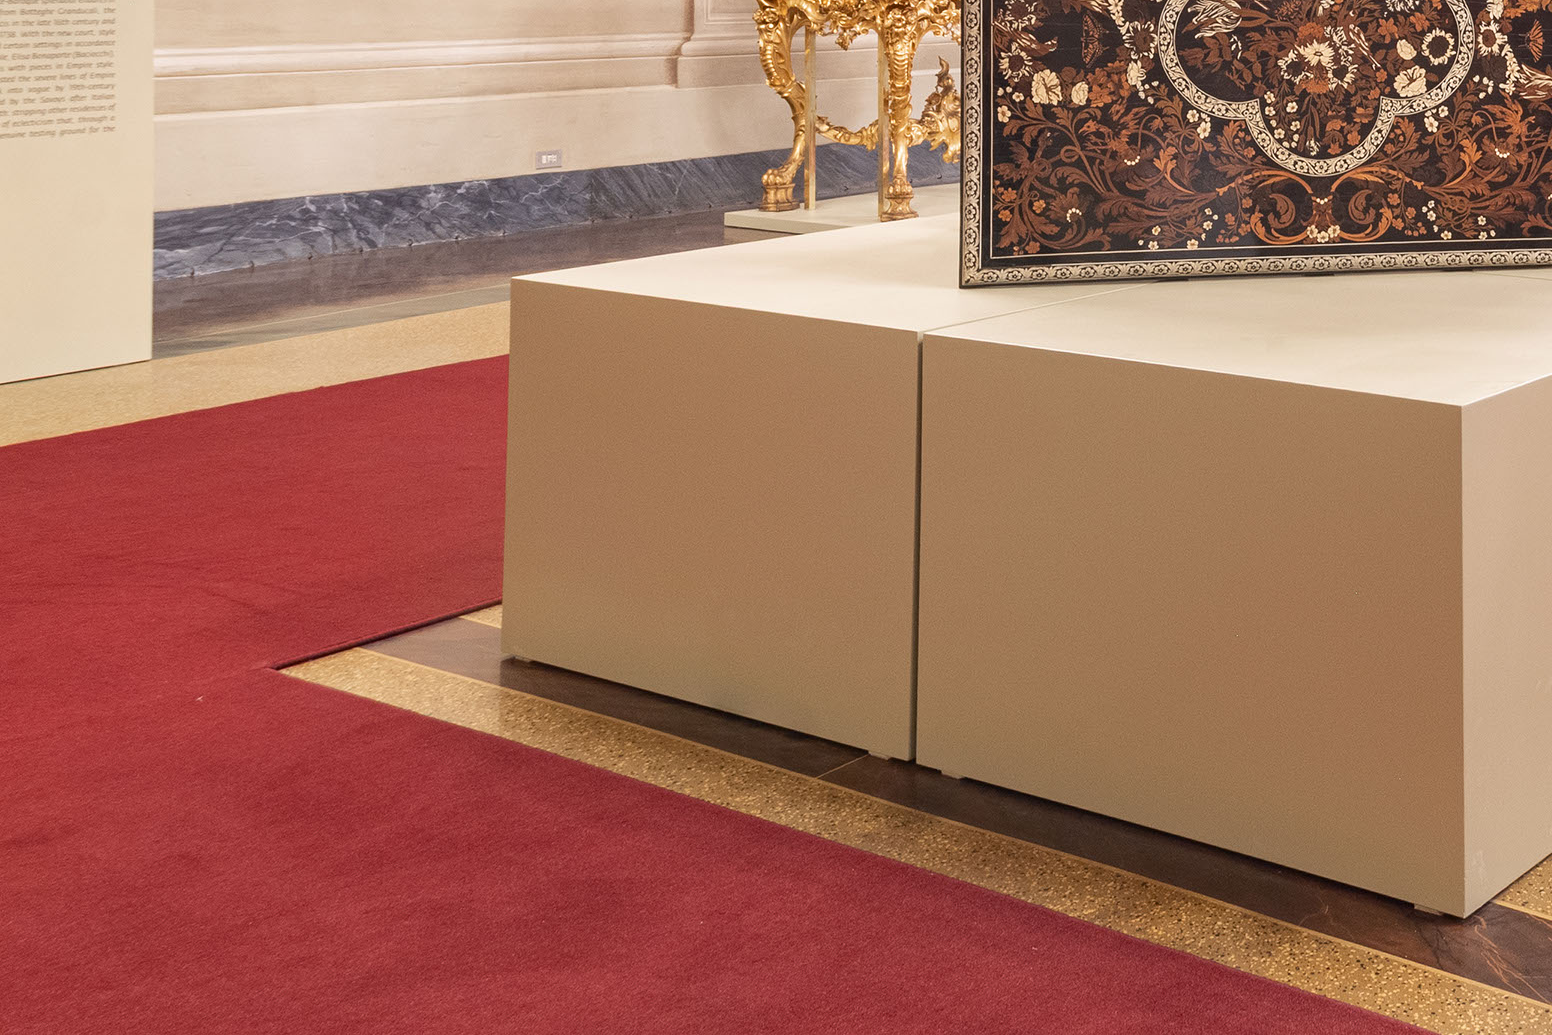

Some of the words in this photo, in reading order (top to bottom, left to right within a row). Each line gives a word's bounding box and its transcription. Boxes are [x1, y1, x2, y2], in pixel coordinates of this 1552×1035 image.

[72, 18, 99, 26] century
[33, 41, 63, 49] settings
[32, 52, 72, 60] Bonaparte
[66, 62, 93, 70] Empire
[90, 72, 115, 80] Empire
